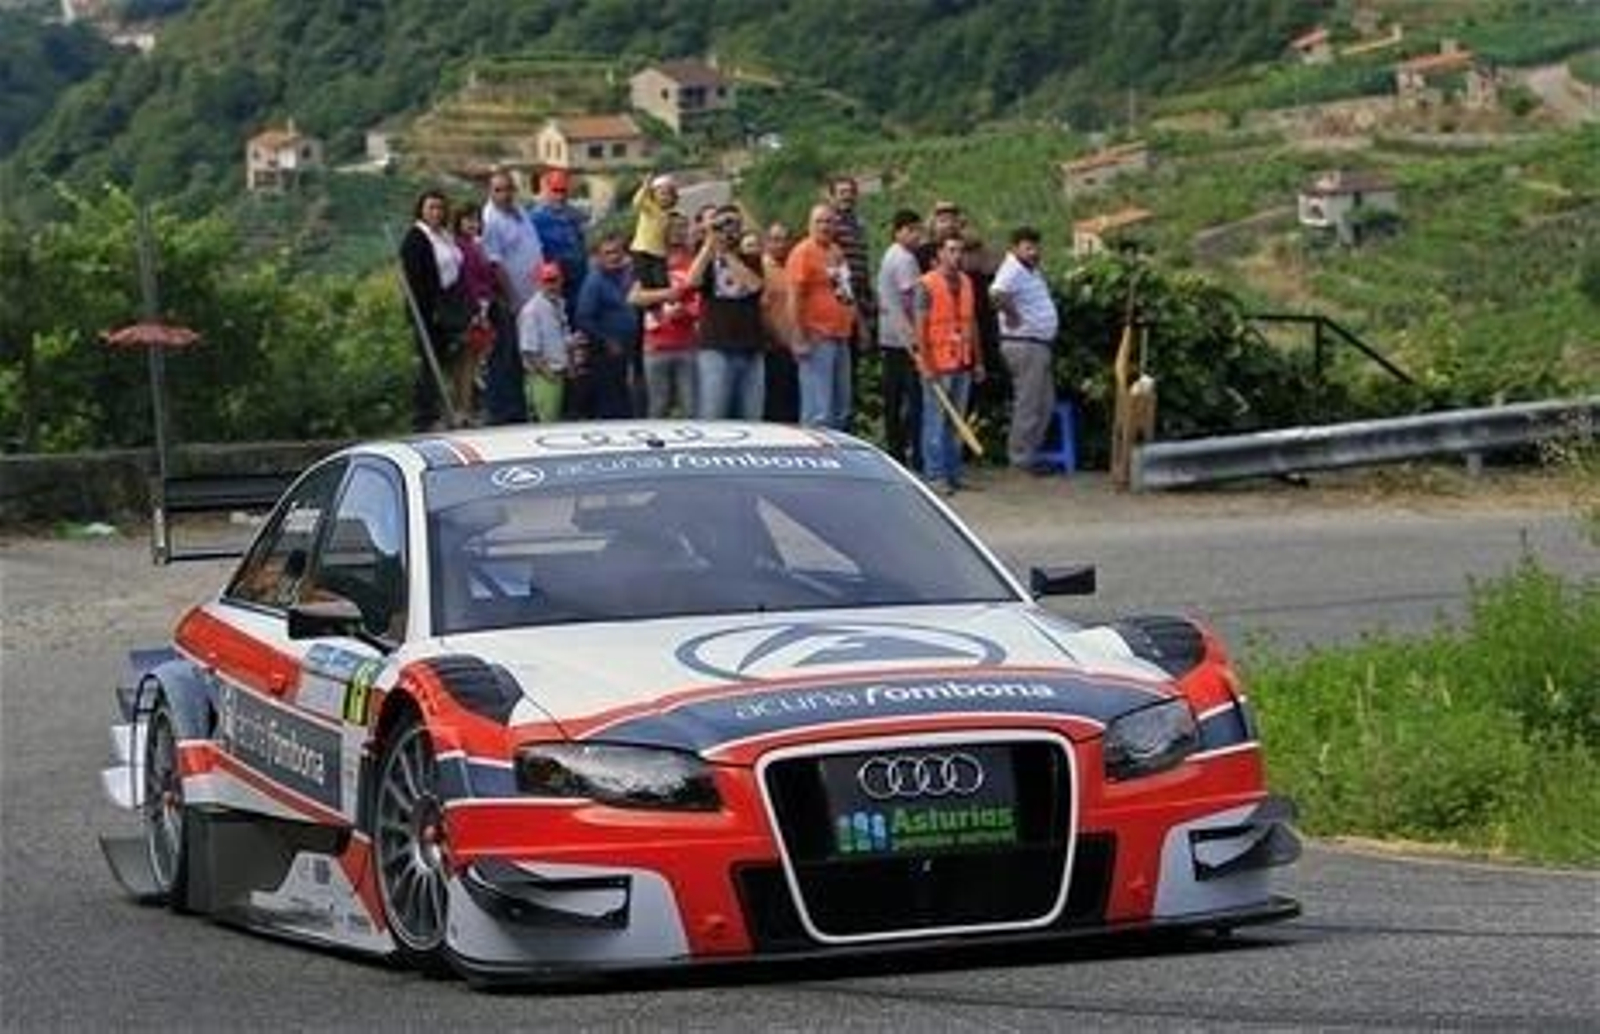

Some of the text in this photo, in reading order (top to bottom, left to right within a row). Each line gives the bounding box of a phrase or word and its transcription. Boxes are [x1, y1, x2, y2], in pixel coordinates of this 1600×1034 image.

[670, 452, 842, 470] fombona
[865, 680, 1055, 706] fombona
[890, 803, 1015, 834] Asturias
